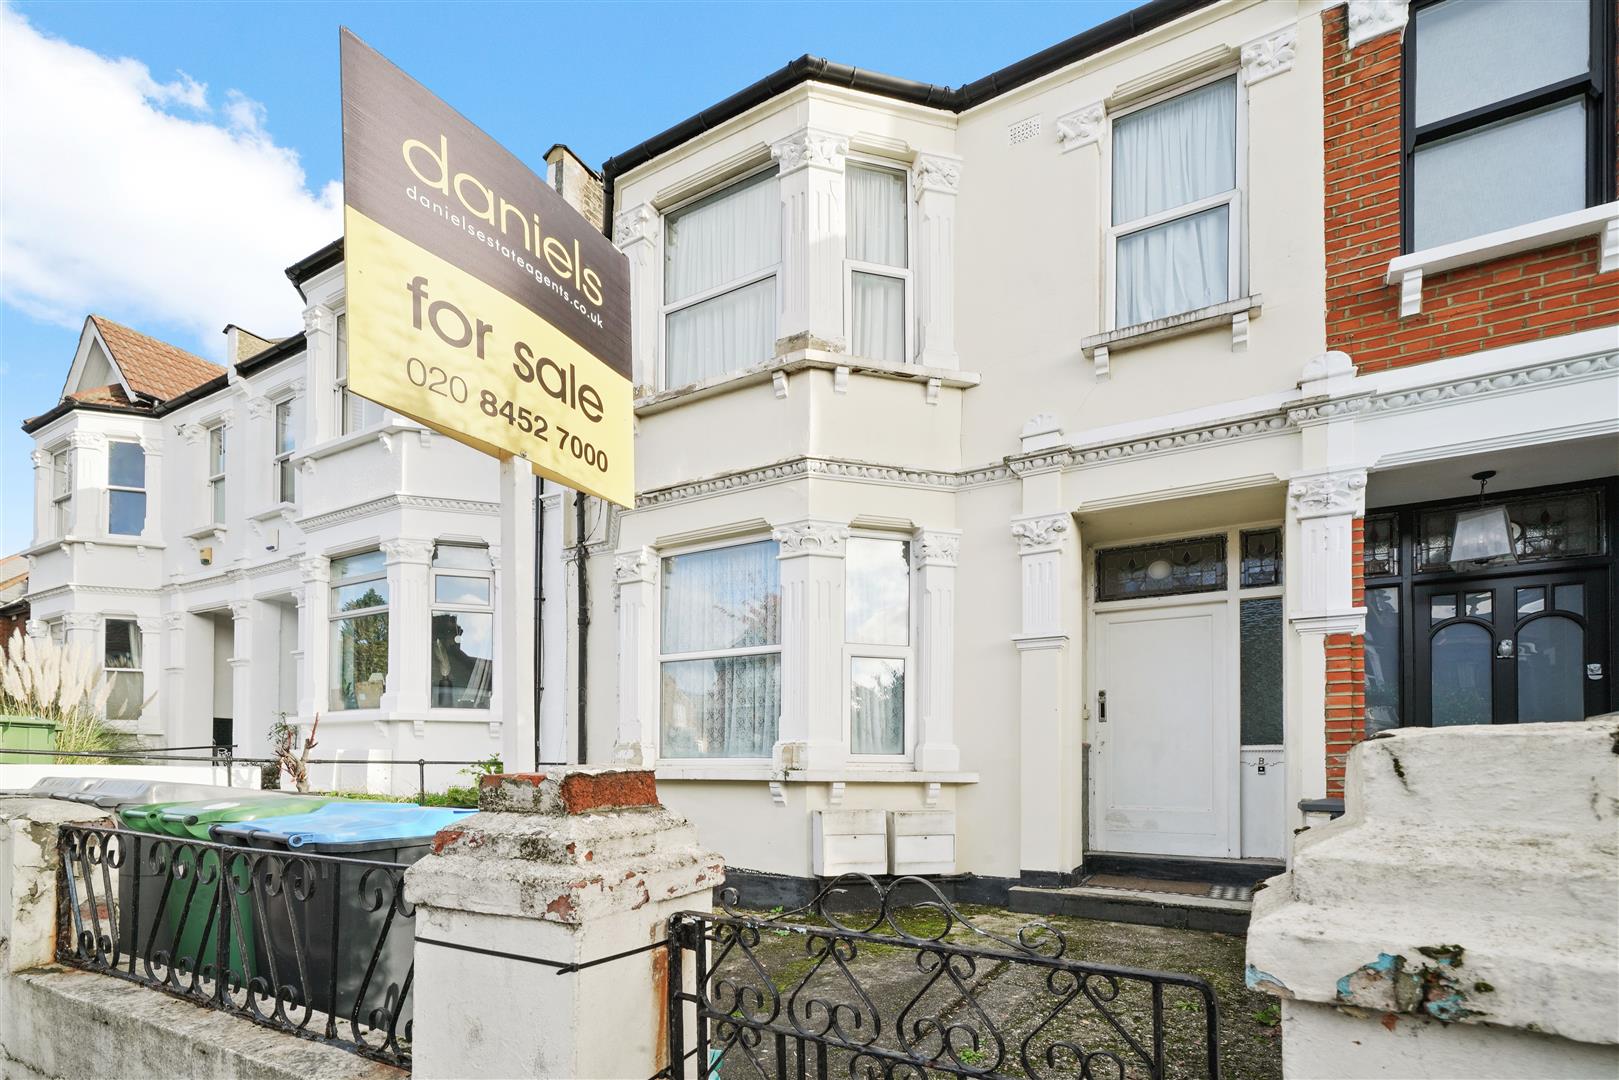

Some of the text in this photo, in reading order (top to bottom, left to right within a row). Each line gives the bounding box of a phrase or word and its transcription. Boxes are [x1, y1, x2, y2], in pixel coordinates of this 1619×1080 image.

[402, 134, 603, 306] daniels
[406, 185, 603, 328] danielsestateagents.co.uk
[406, 276, 604, 423] for sale
[406, 357, 609, 473] 020 8452 7000
